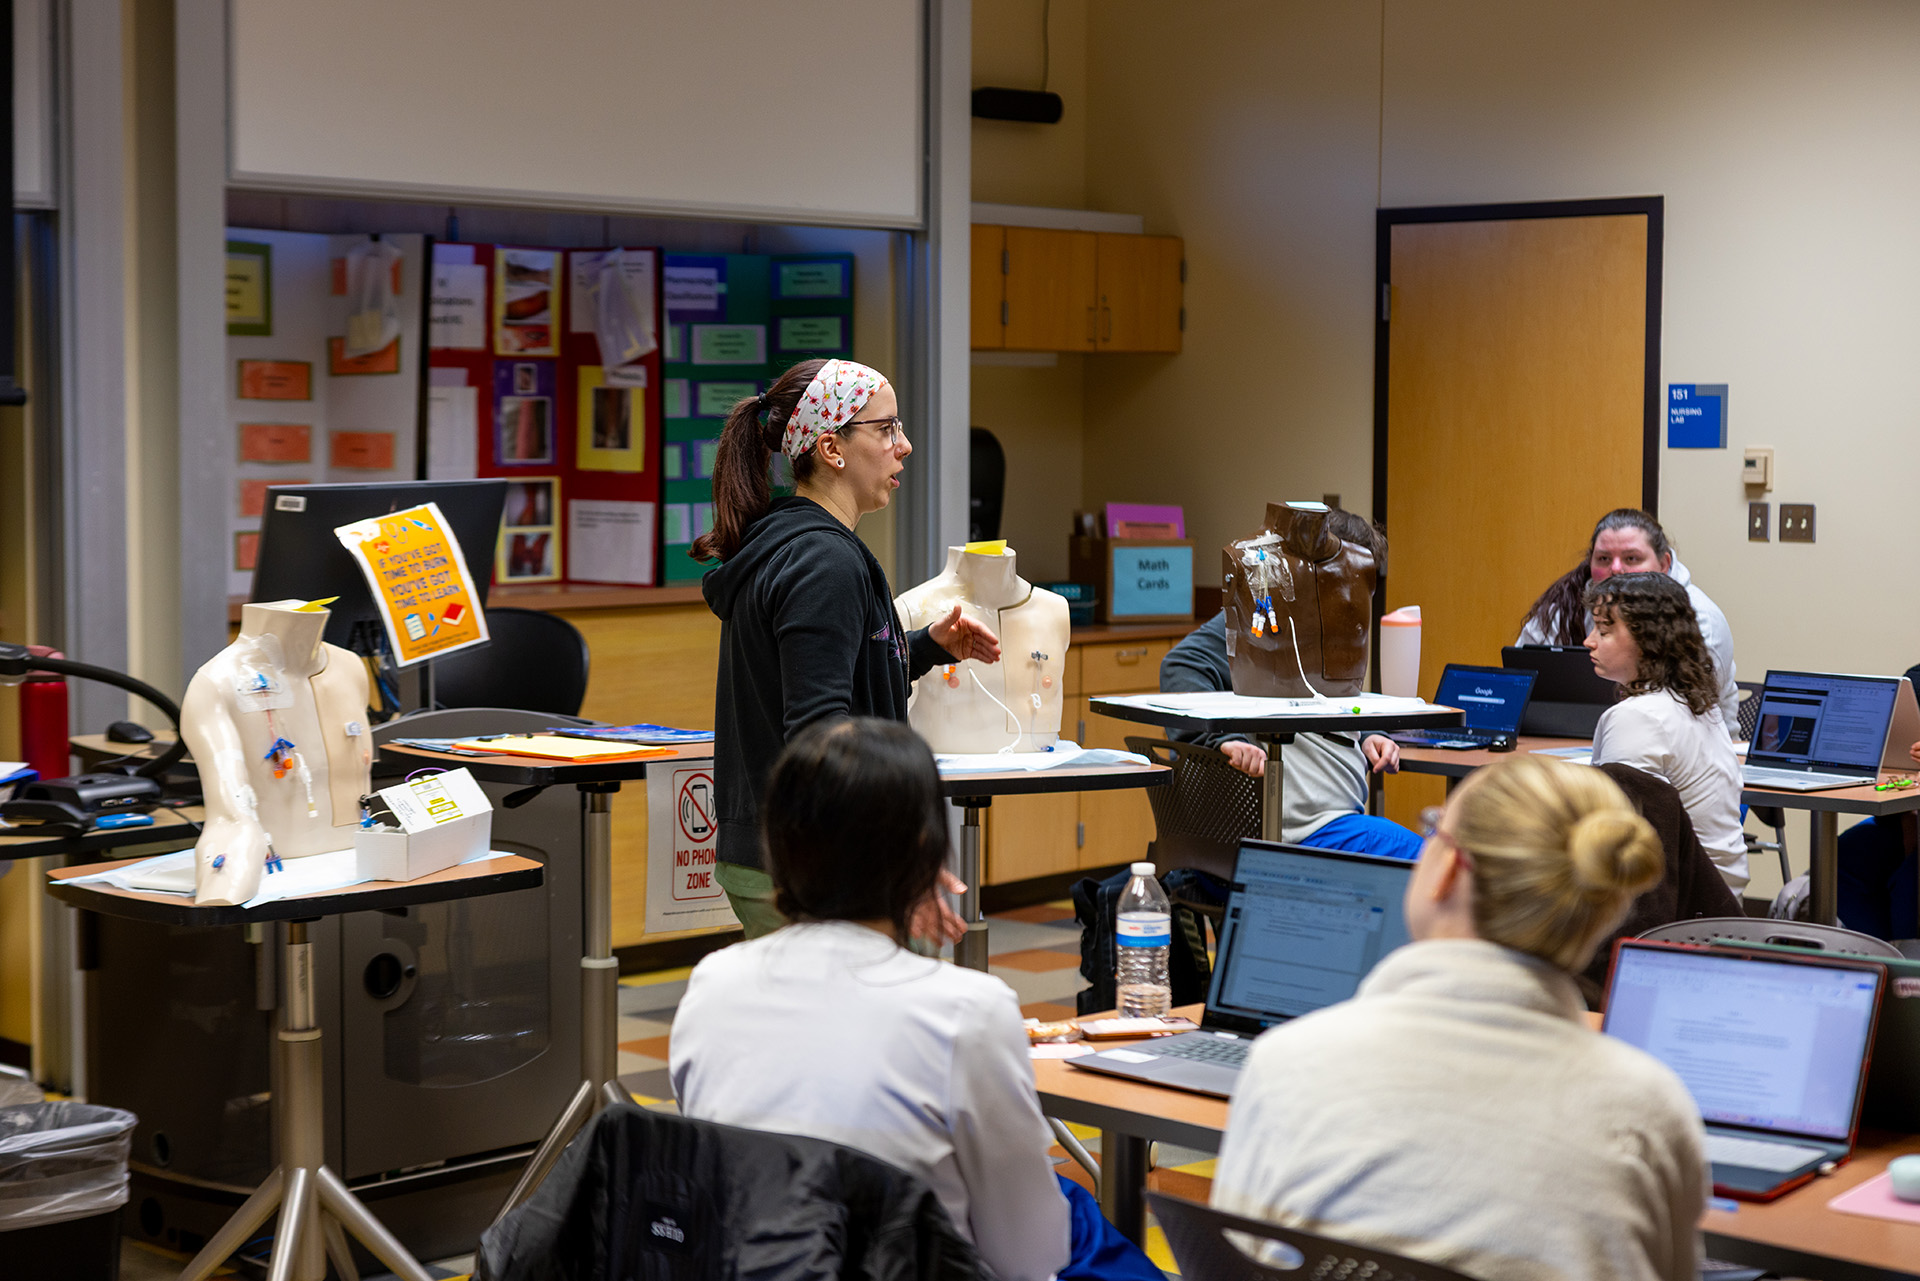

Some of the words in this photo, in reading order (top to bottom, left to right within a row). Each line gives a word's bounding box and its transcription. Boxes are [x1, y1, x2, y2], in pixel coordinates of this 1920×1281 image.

[1671, 388, 1688, 400] 151
[1671, 407, 1702, 416] NURSING
[1671, 415, 1685, 424] LAB
[377, 558, 386, 569] IF
[389, 549, 423, 565] YOU'VE
[423, 543, 443, 556] GOT
[382, 566, 408, 581] TIME
[408, 562, 422, 574] TO
[422, 556, 449, 571] BURN
[1138, 559, 1170, 572] Math
[388, 577, 428, 597] YOU'VE
[430, 570, 452, 586] GOT
[1137, 578, 1170, 591] Cards
[394, 595, 418, 610] TIME
[418, 592, 432, 604] TO
[1474, 687, 1493, 696] Google
[676, 850, 690, 867] NO
[692, 848, 717, 865] PHON
[686, 872, 711, 890] ZONE
